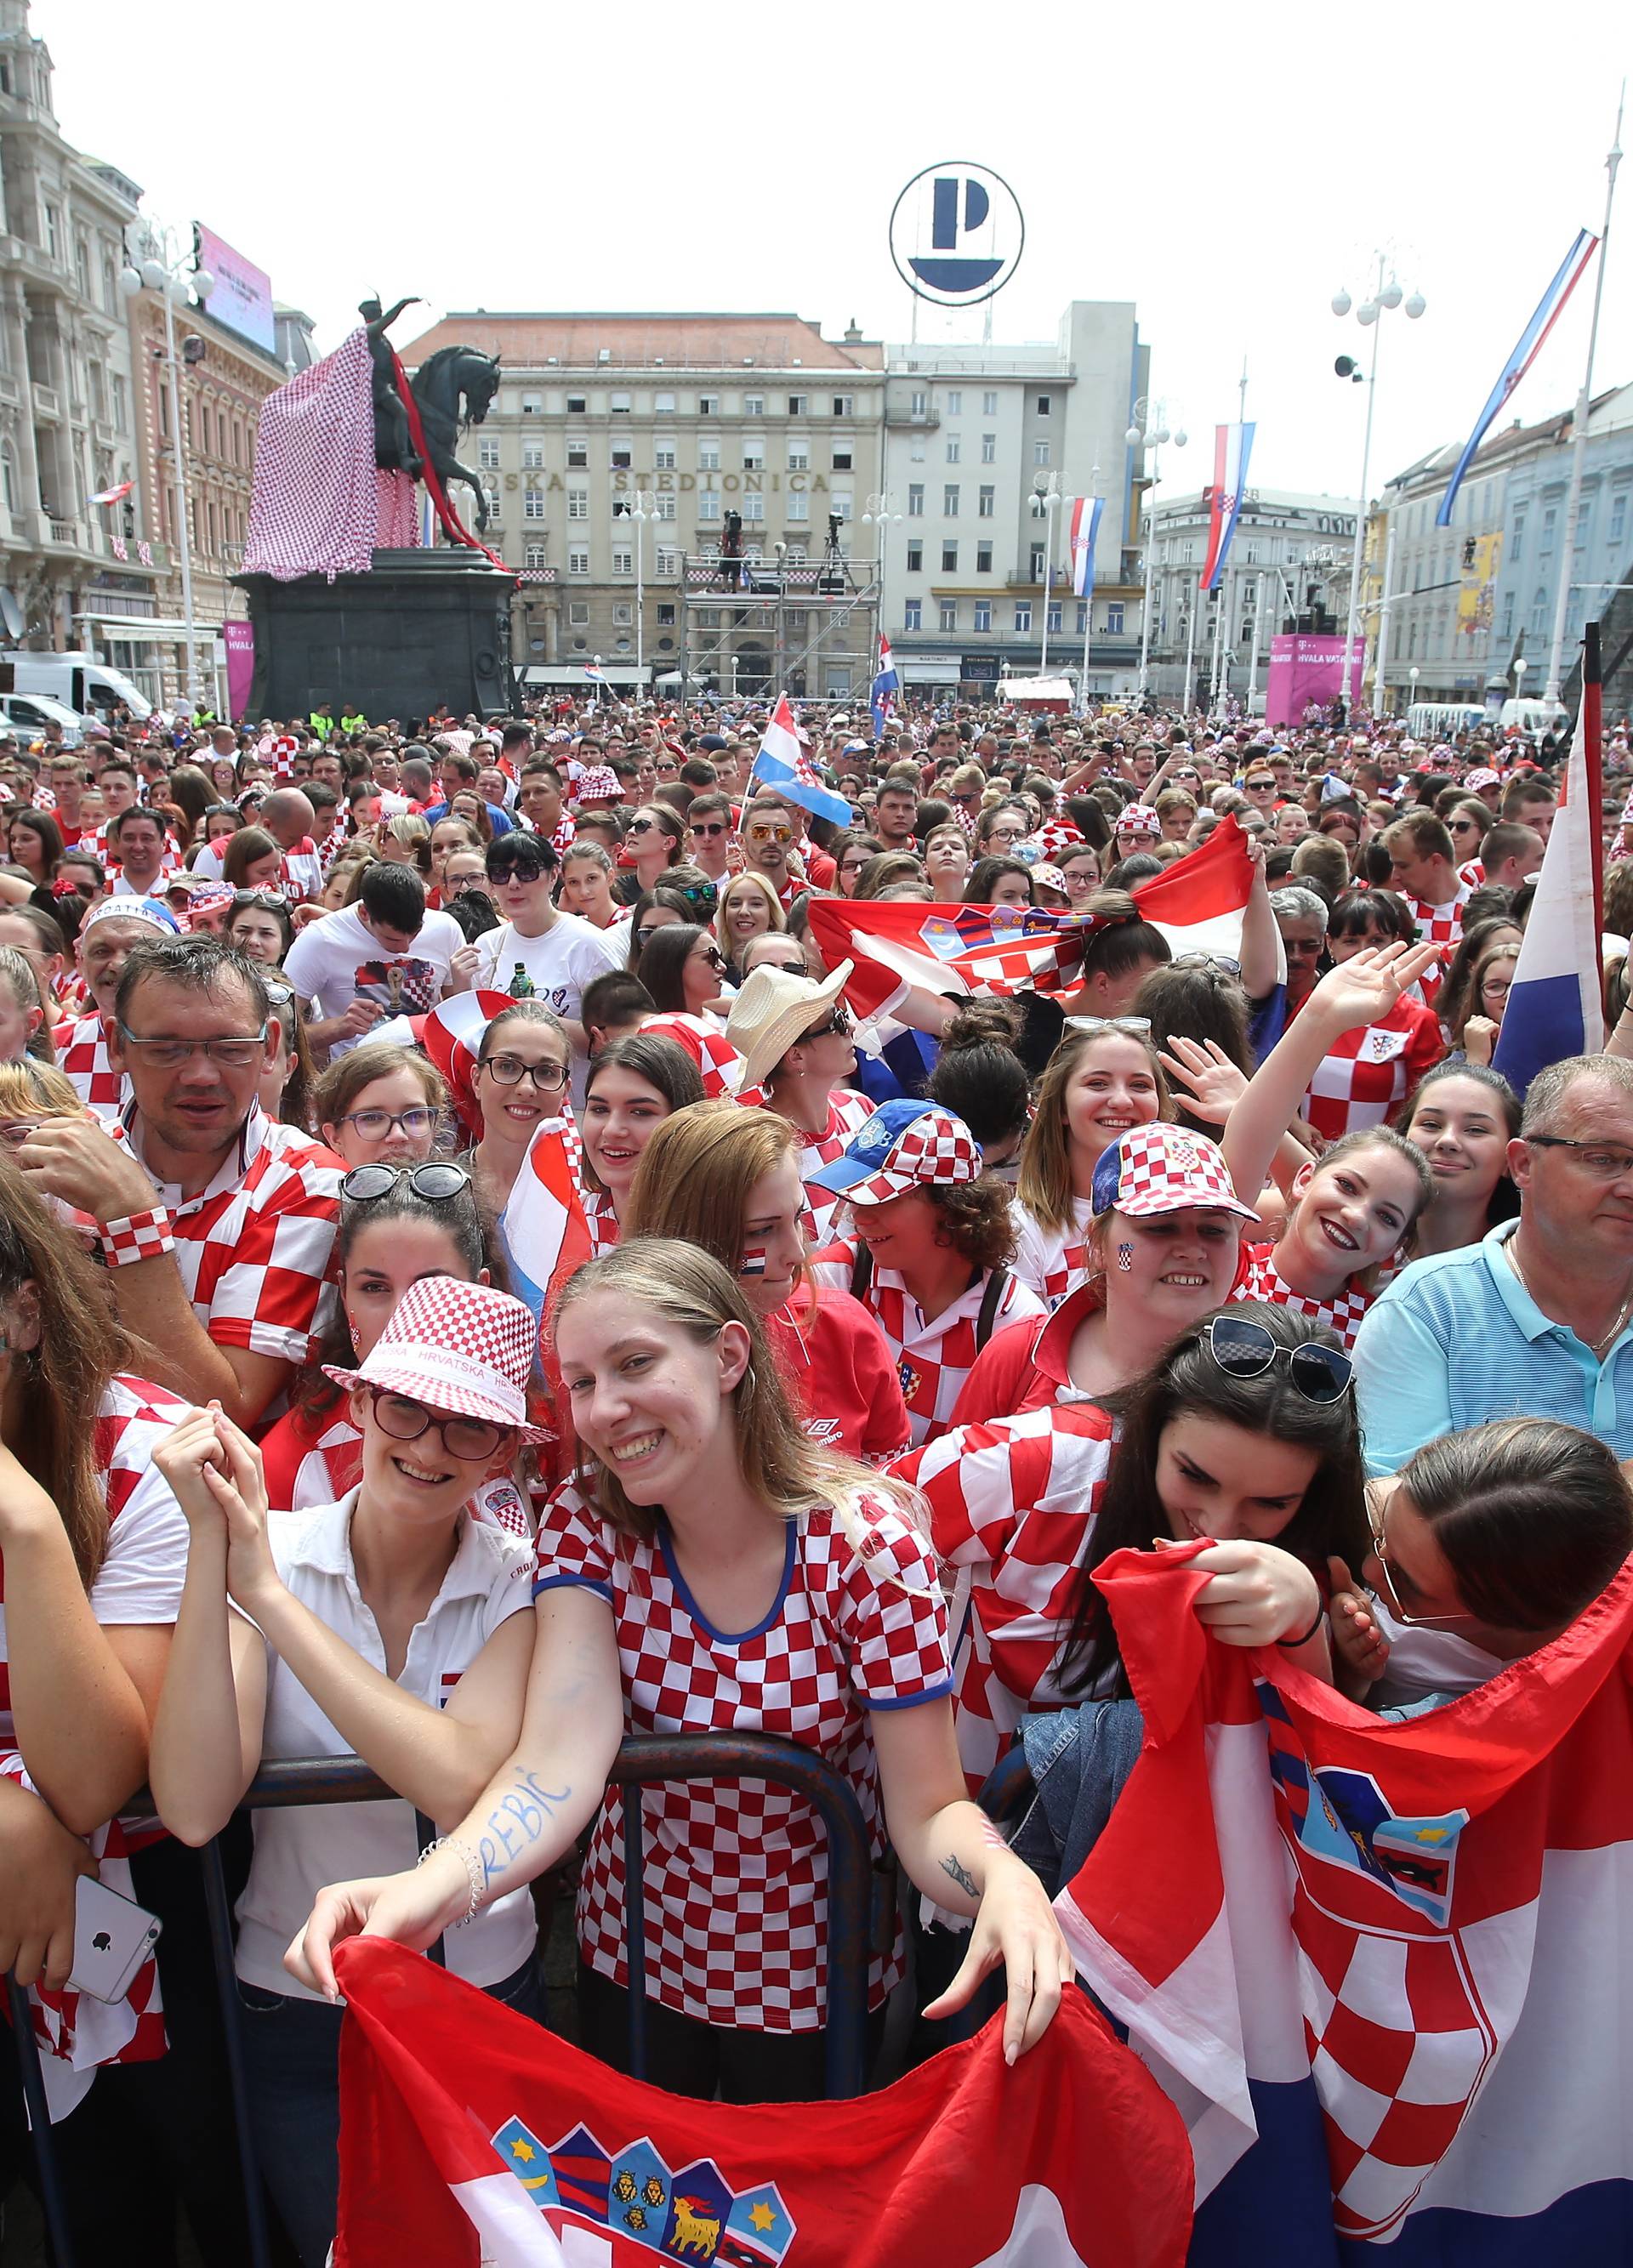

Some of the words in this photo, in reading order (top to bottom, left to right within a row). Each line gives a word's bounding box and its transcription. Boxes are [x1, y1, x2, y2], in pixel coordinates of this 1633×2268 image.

[932, 179, 989, 250] P
[1298, 653, 1324, 663] HVALA
[418, 1350, 486, 1379] HRVATSKA
